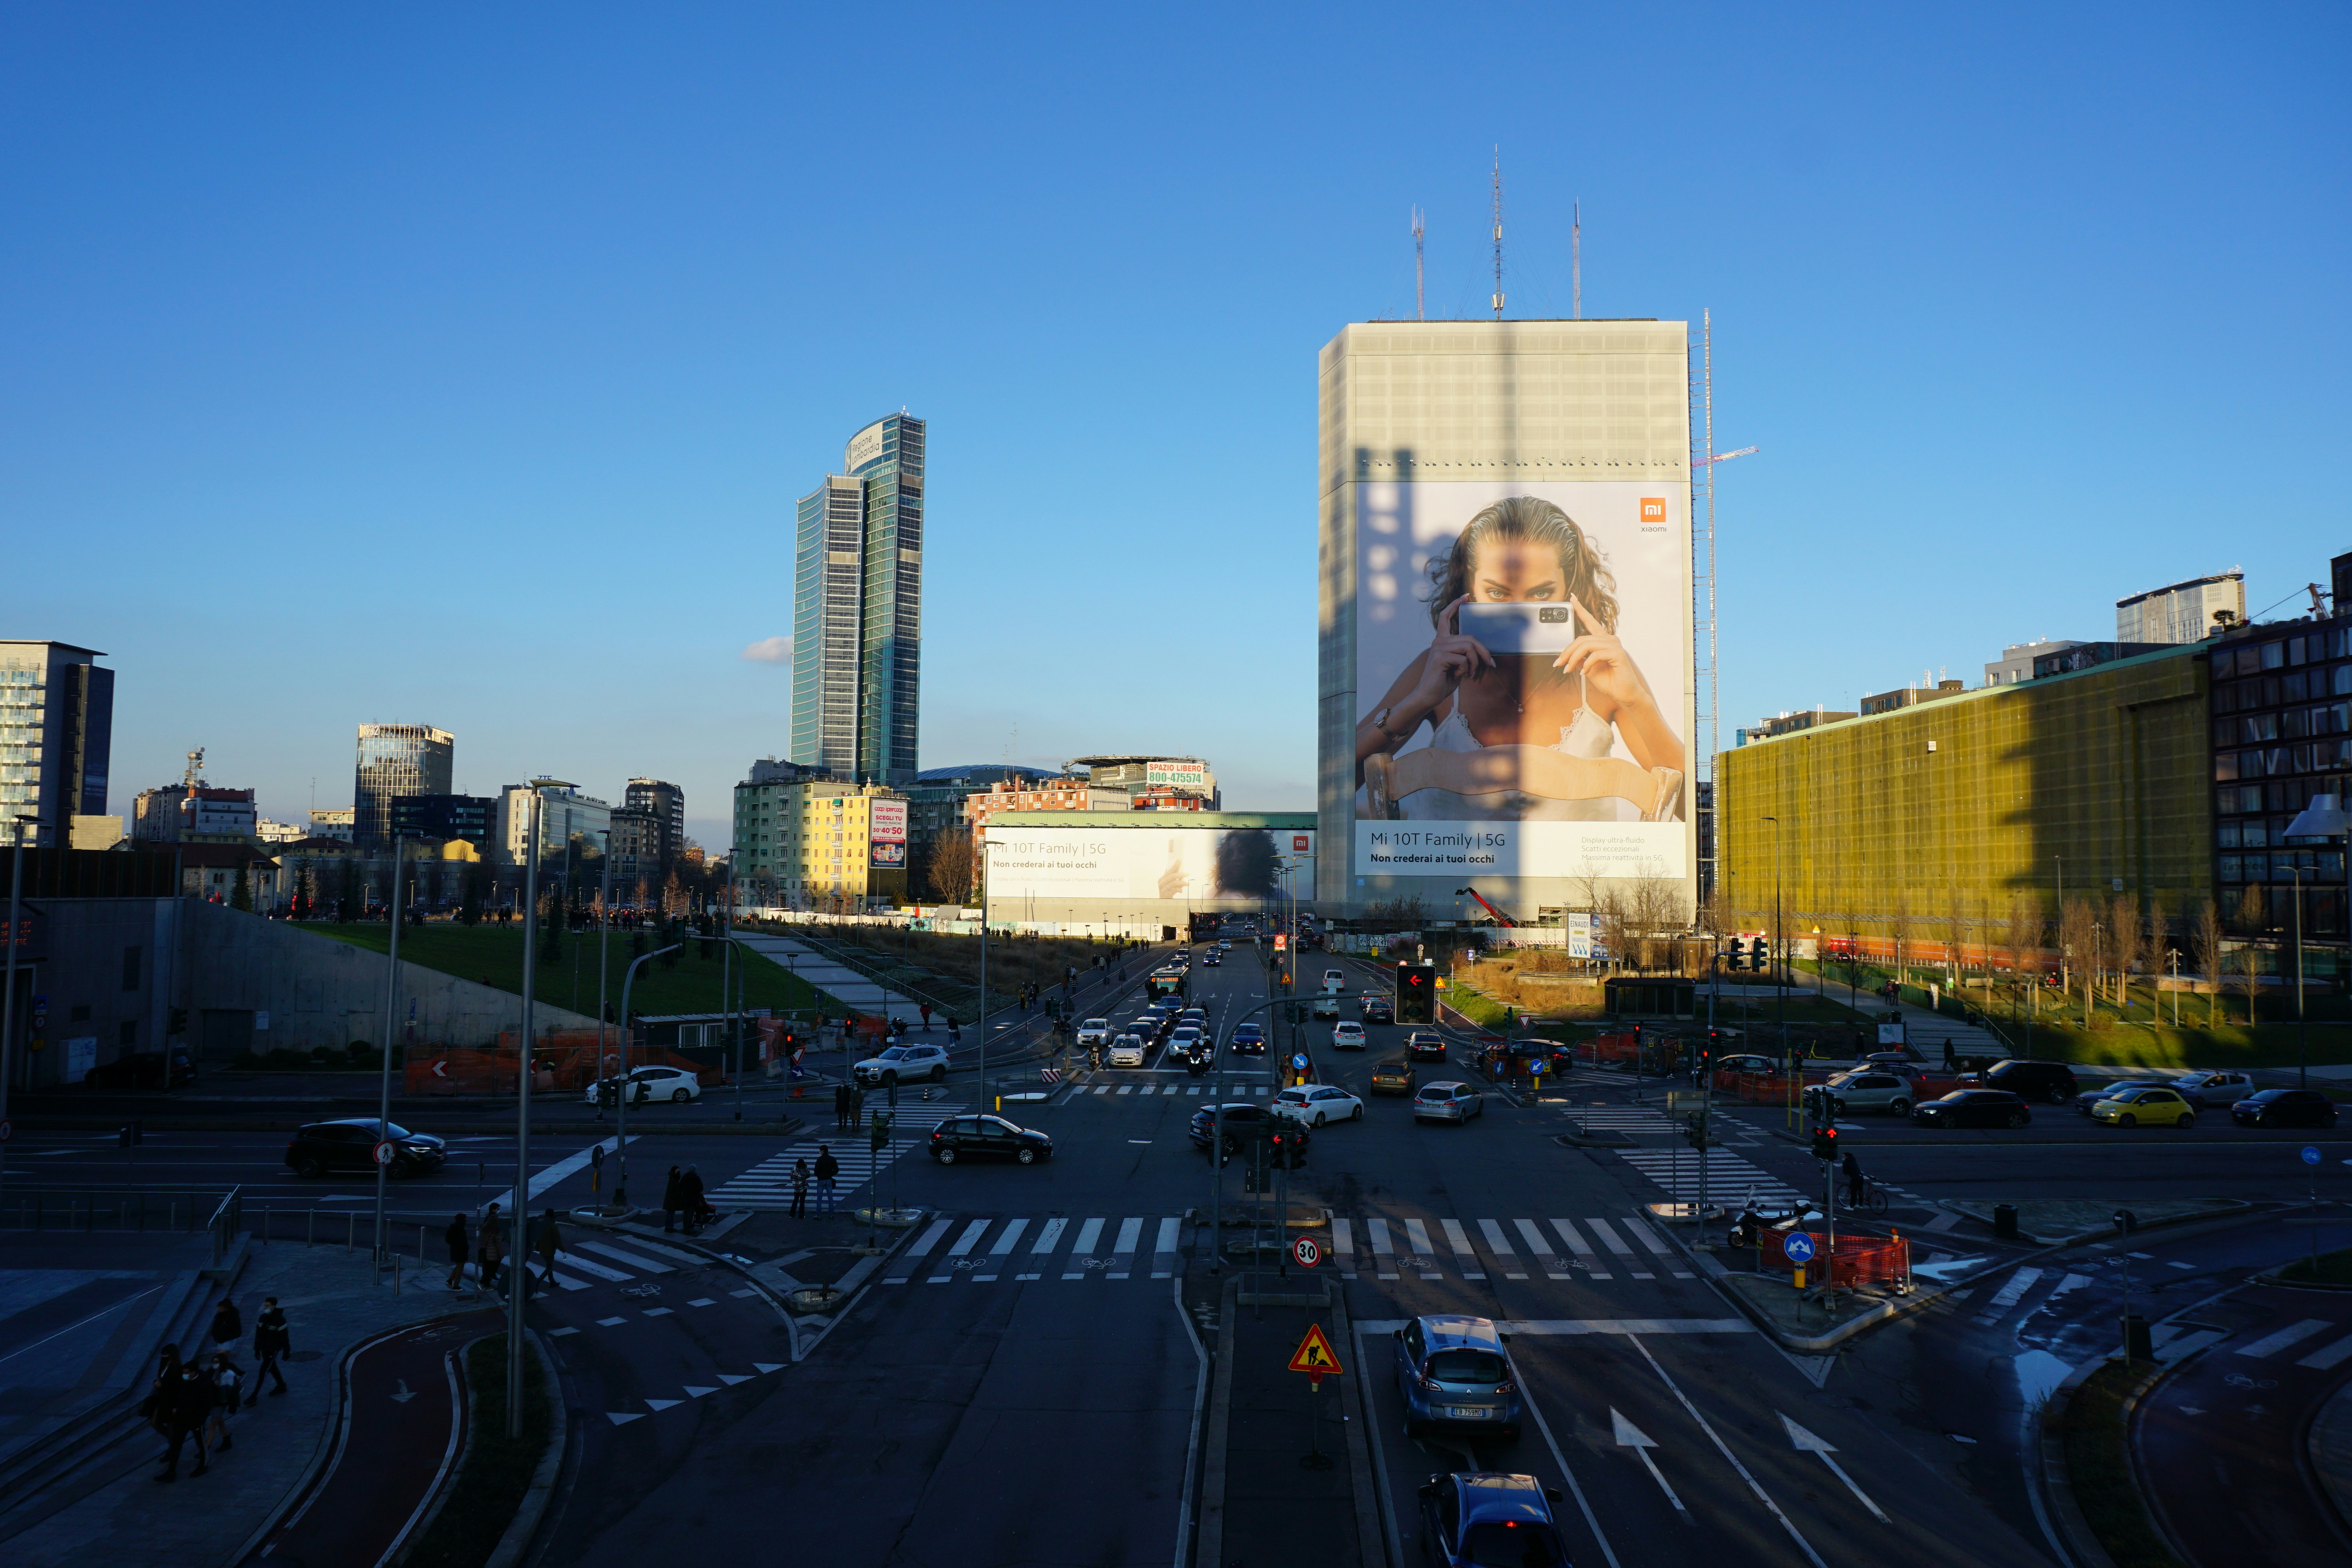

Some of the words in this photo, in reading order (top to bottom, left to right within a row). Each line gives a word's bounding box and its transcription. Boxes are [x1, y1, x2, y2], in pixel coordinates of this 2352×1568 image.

[853, 436, 872, 454] Regione
[852, 443, 879, 465] Lombardia
[1149, 772, 1201, 783] 800-475574
[1372, 833, 1387, 845] Mi
[1394, 833, 1420, 845] 10T
[1426, 833, 1472, 849] Family
[1486, 834, 1505, 846] 5G
[994, 843, 1007, 853] Mi
[1013, 843, 1035, 853] 10T
[1040, 843, 1078, 857] Family
[1090, 844, 1105, 854] 5G
[1393, 854, 1432, 862] crederai
[1469, 855, 1494, 863] occhi
[1299, 1244, 1316, 1259] 30
